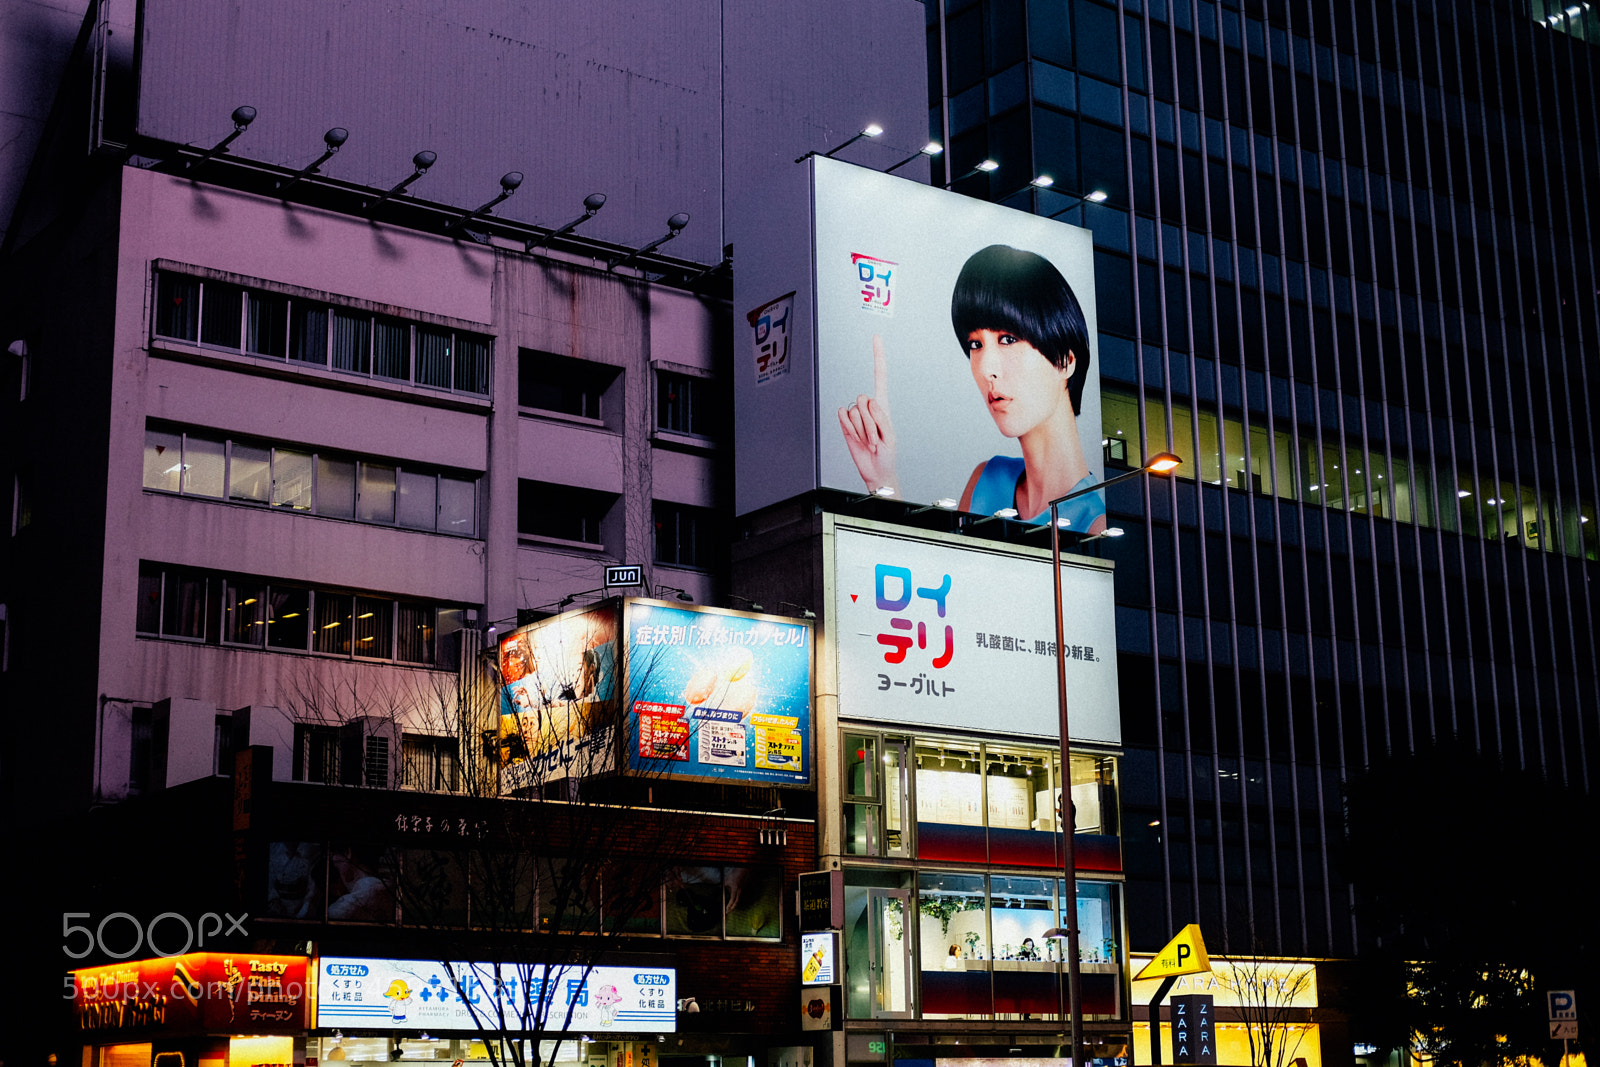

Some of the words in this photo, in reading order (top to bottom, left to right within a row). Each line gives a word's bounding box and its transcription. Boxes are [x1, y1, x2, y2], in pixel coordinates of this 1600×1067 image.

[612, 570, 635, 582] JUN
[975, 632, 1101, 663] 乳酸菌に、期待の新星。
[877, 673, 956, 697] ヨーグルト
[1177, 944, 1191, 968] P
[249, 960, 288, 975] Tasty
[330, 965, 366, 976] 処方せん
[248, 975, 282, 988] Thai
[332, 979, 363, 989] くすり
[636, 974, 668, 985] 処方せん
[1177, 977, 1221, 991] ARA
[1230, 977, 1290, 992] HOME
[248, 990, 297, 1006] Dining
[331, 992, 363, 1002] 化粧品
[639, 987, 664, 997] くすり
[638, 998, 665, 1009] 化粧品
[1550, 993, 1573, 1018] P
[1177, 1004, 1189, 1057] ZARA
[1200, 1003, 1211, 1056] ZARA
